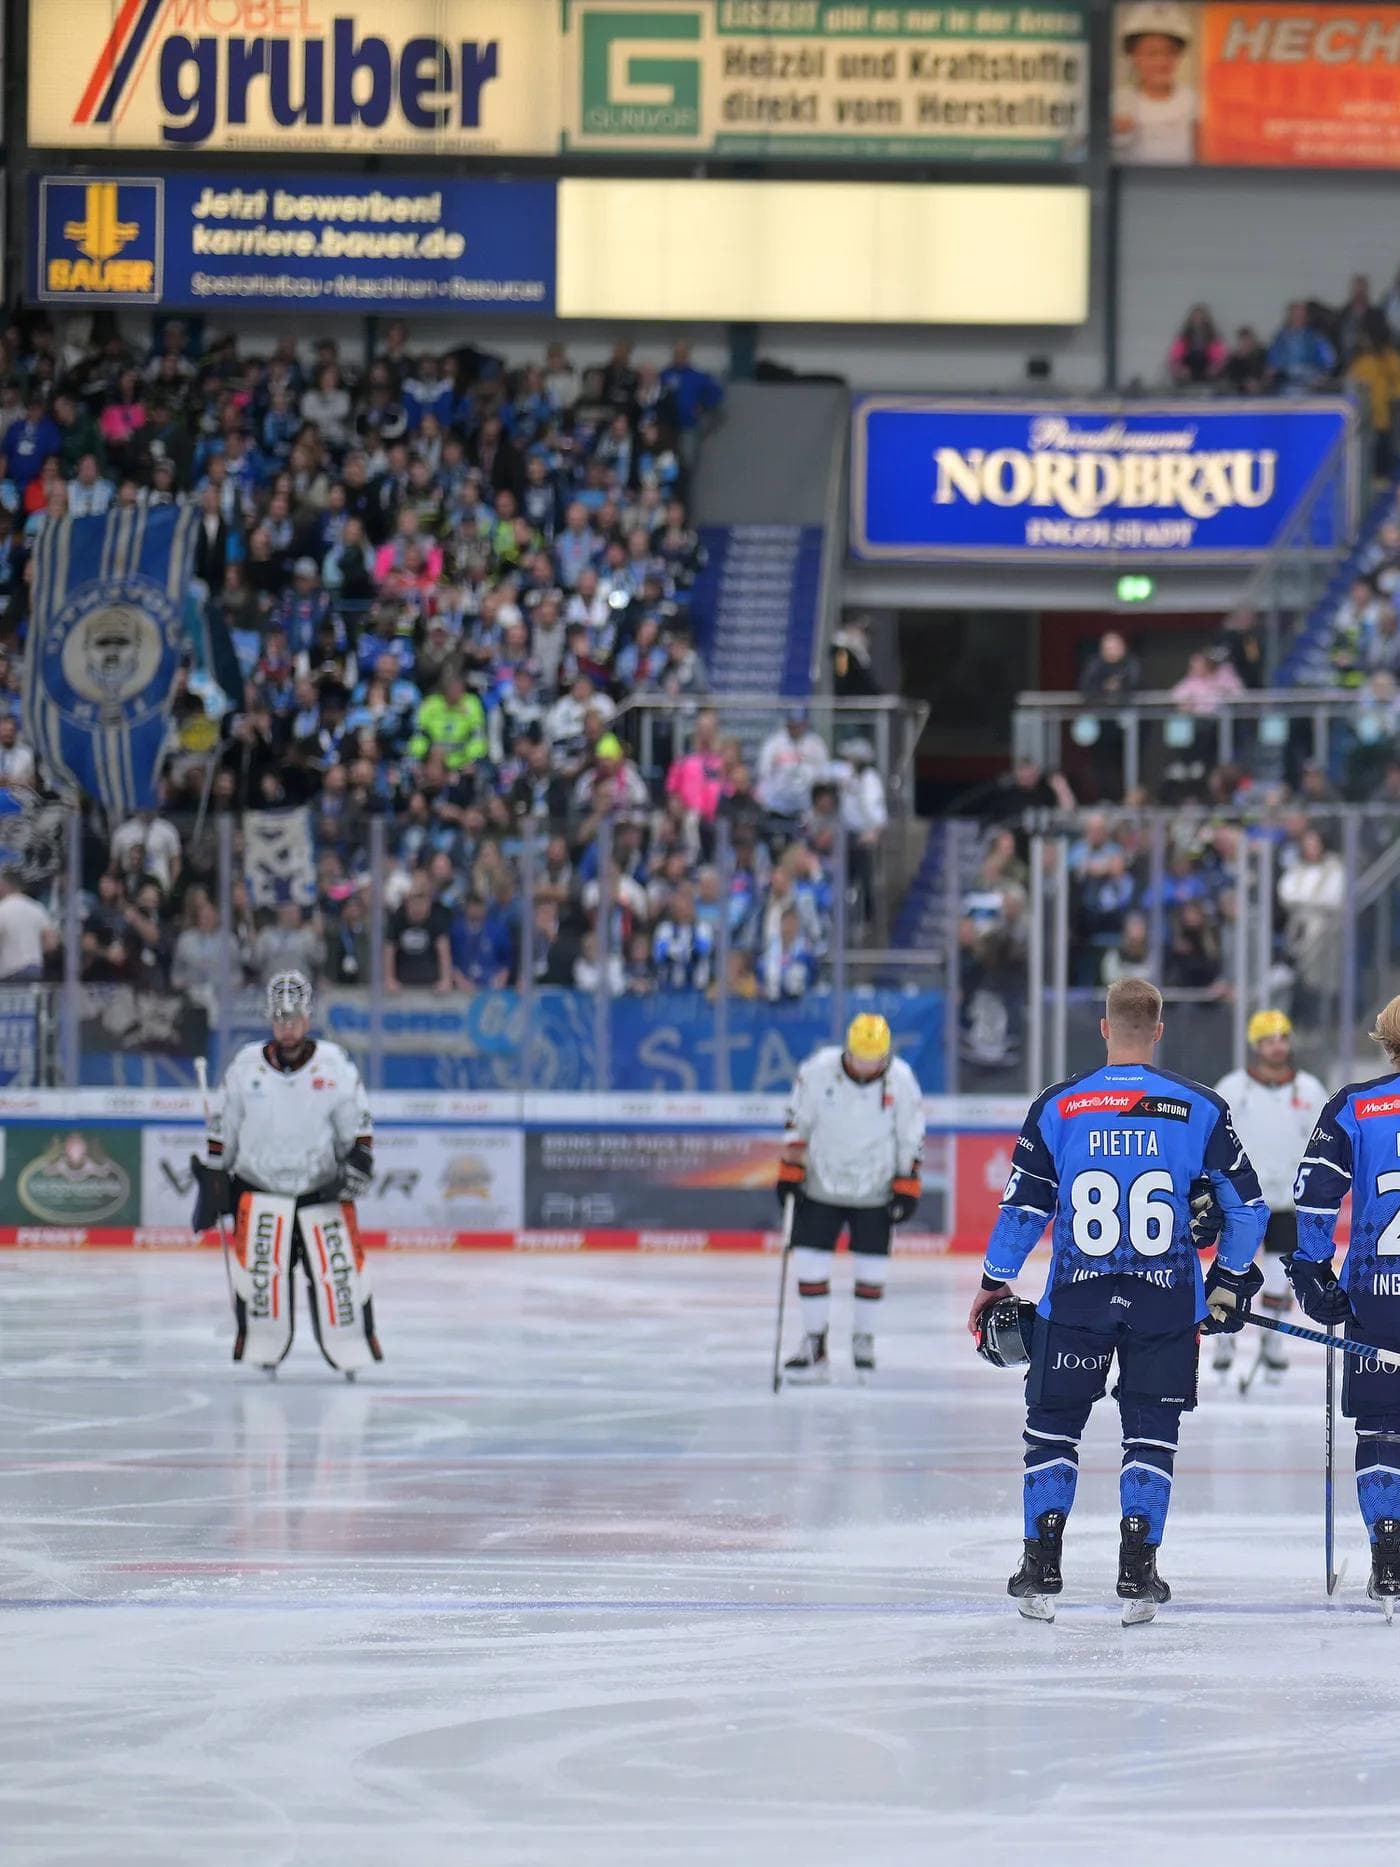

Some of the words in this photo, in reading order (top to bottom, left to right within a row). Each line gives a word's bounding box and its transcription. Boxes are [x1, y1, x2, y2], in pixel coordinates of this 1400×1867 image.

[160, 17, 498, 146] gruber
[837, 48, 897, 80] und
[835, 98, 903, 125] vom
[917, 93, 1079, 127] Hersteller
[192, 187, 268, 220] Jetzt
[273, 190, 442, 223] bewerben!
[192, 224, 466, 260] karriere.bauer.de
[49, 260, 154, 292] BAUER
[1157, 1102, 1188, 1117] SATURN
[1088, 1129, 1160, 1158] PIETTA
[1071, 1169, 1174, 1258] 86
[249, 1212, 274, 1317] techem
[323, 1219, 355, 1327] techem
